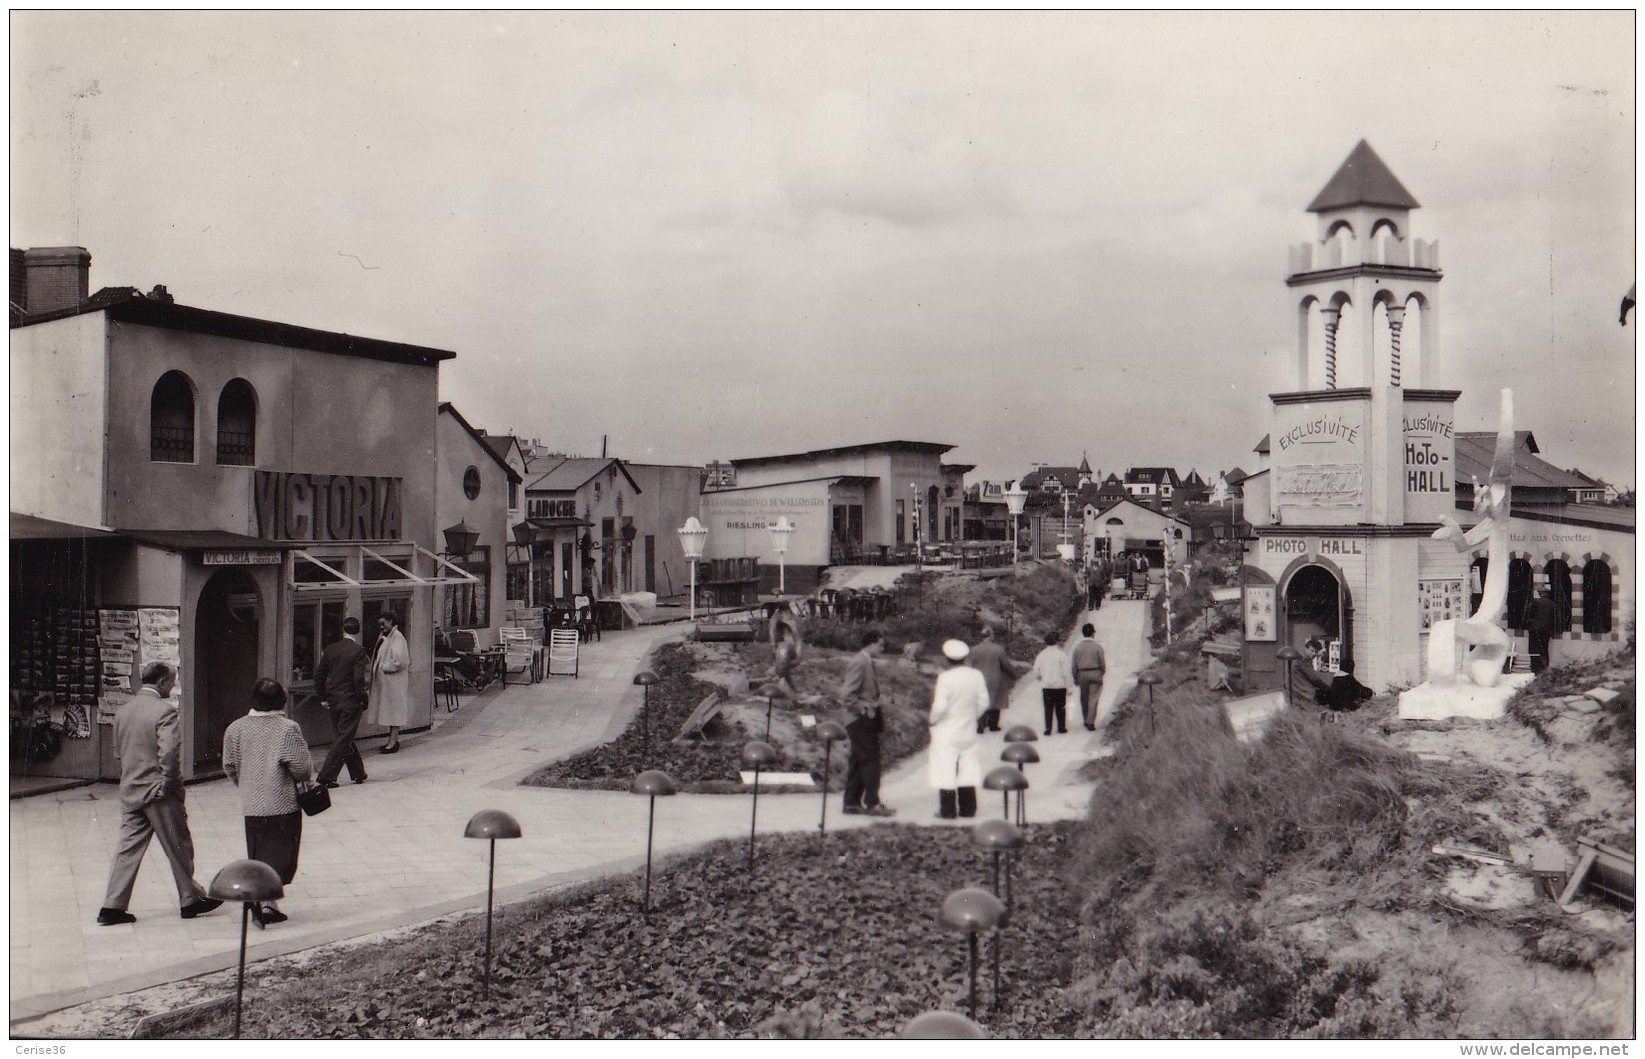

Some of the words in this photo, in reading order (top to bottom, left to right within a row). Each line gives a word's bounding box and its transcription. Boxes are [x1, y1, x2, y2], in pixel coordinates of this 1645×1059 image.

[1408, 471, 1450, 492] HALL
[254, 470, 403, 541] VICTORIA
[528, 499, 576, 518] LAROCHE
[726, 521, 766, 530] RIESLING
[1266, 539, 1306, 553] PHOTO
[1321, 540, 1361, 554] HALL
[204, 551, 250, 564] VICTORIA
